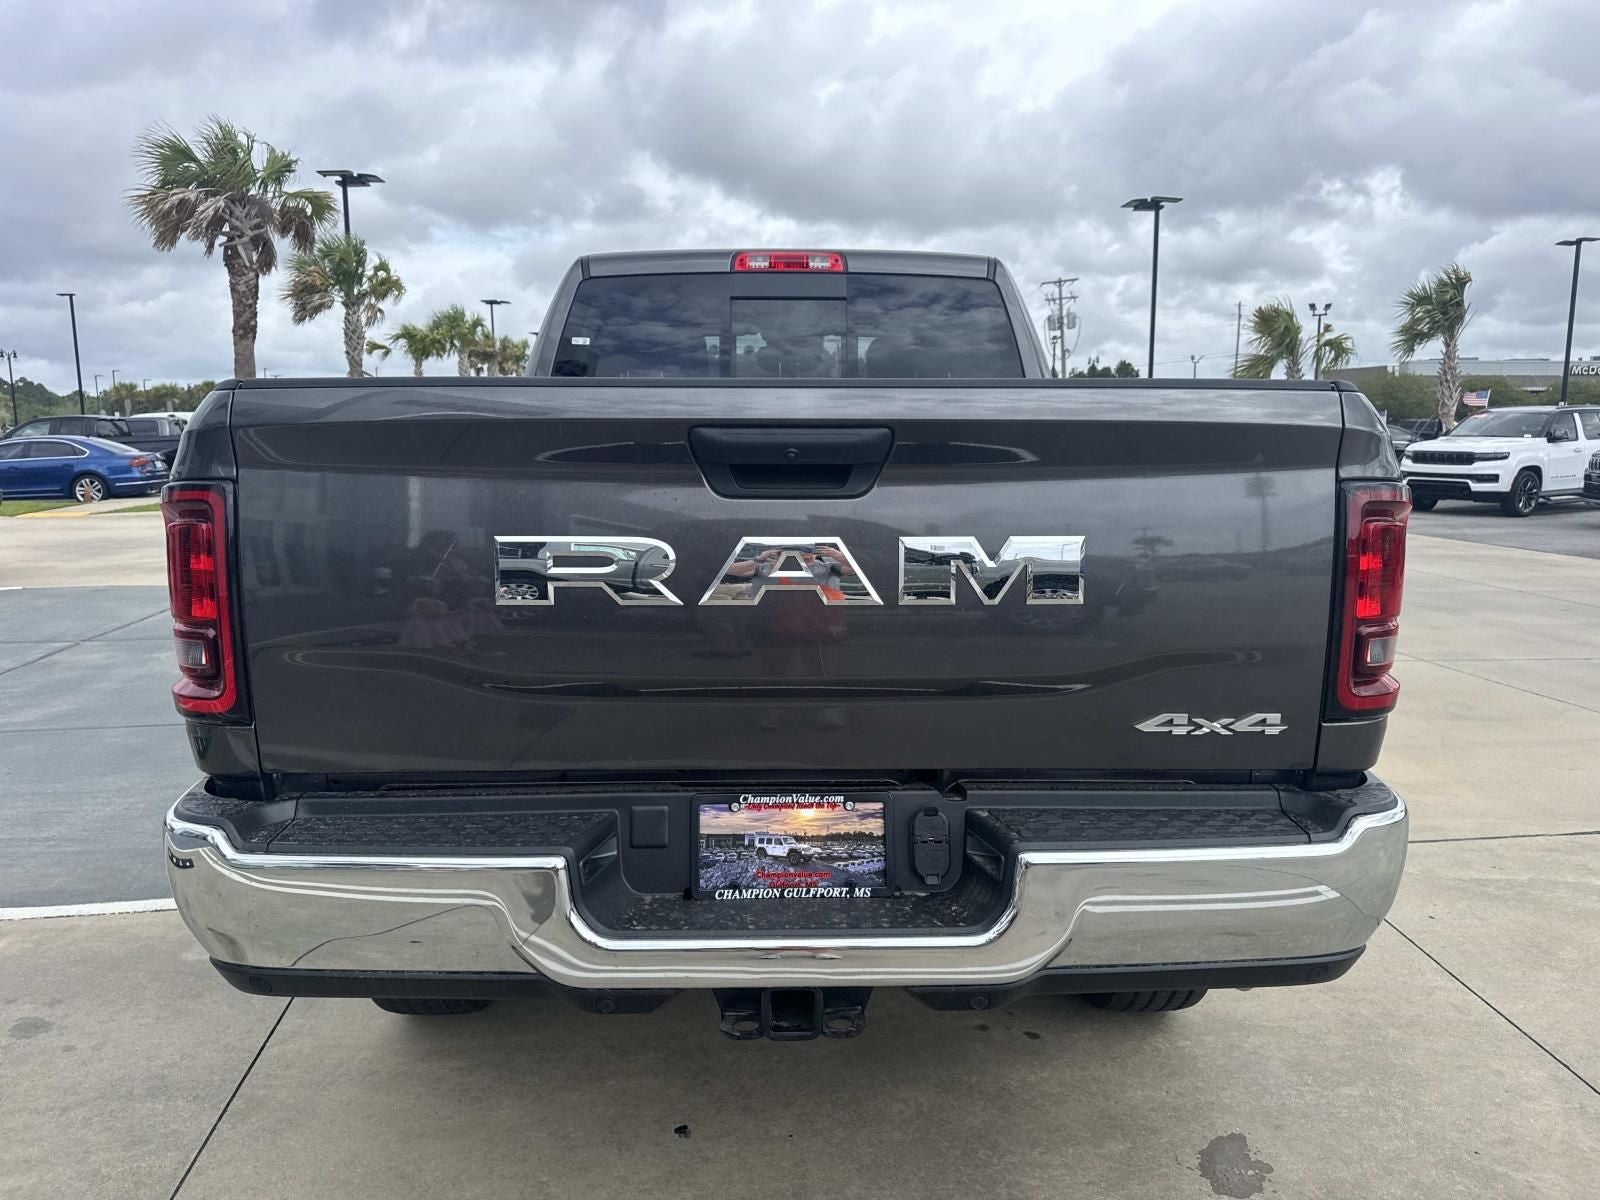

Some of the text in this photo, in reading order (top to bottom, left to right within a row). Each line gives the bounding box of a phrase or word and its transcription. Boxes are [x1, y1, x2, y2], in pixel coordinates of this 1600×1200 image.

[494, 536, 1086, 606] RAM
[1134, 713, 1288, 735] 4x4
[740, 794, 844, 805] ChampionValue.com
[756, 870, 832, 879] Championvalue.com
[715, 887, 872, 900] CHAMPION GULFPORT, MS
